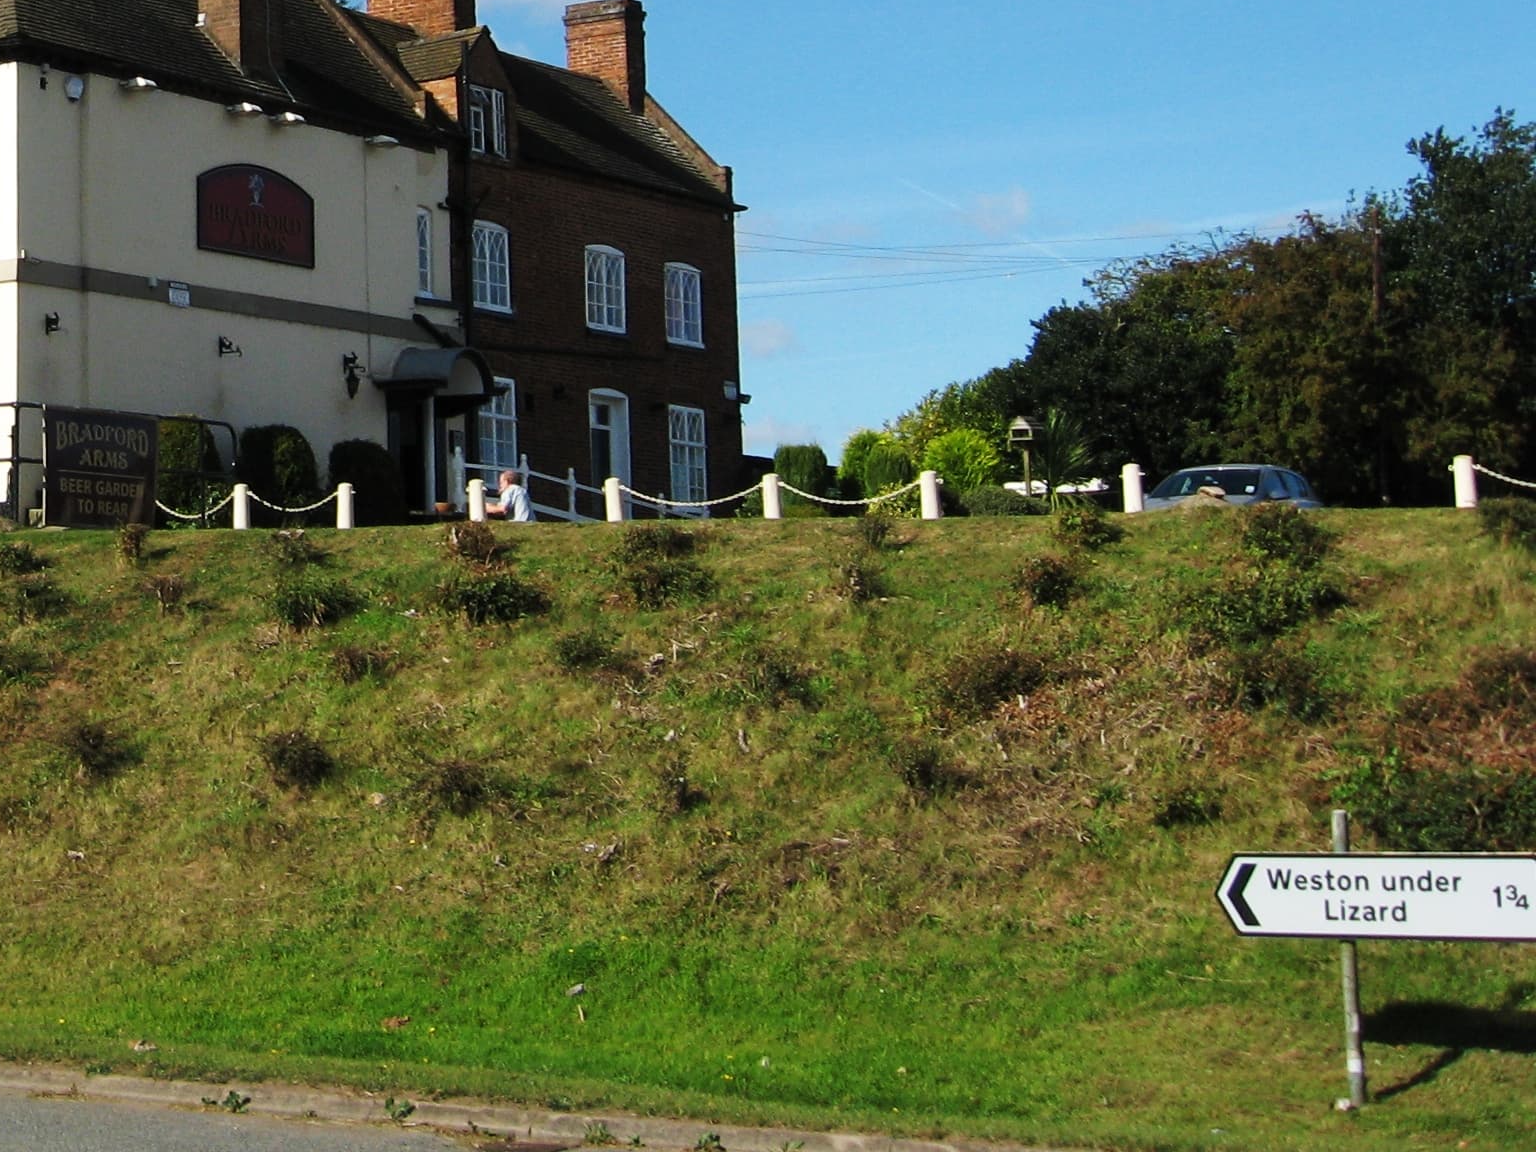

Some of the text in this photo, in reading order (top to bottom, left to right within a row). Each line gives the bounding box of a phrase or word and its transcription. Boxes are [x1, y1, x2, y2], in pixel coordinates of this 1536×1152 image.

[56, 421, 149, 457] BRADFORD
[80, 449, 128, 469] ARMS
[60, 478, 144, 497] BEER GARDEN
[78, 499, 128, 516] TO REAR
[1267, 868, 1461, 892] Weston under
[1324, 899, 1407, 922] Lizard
